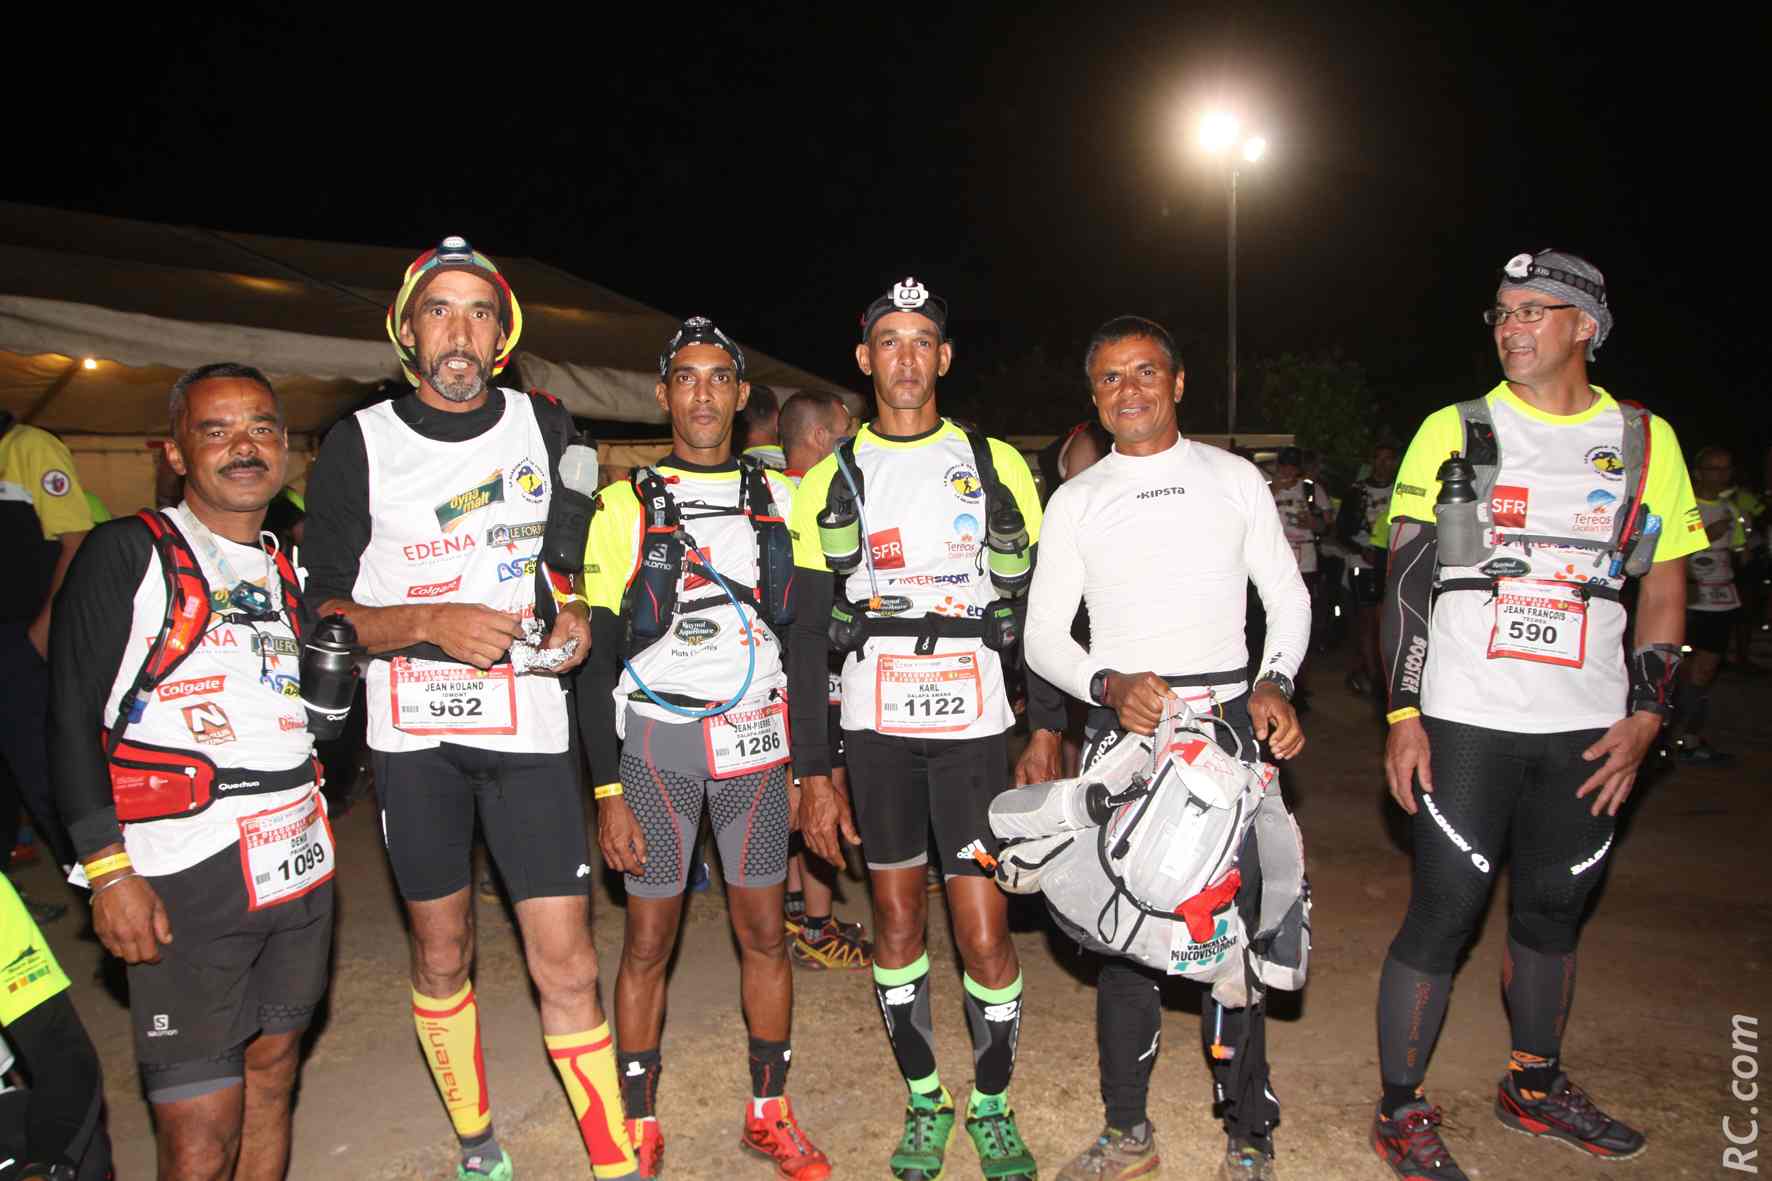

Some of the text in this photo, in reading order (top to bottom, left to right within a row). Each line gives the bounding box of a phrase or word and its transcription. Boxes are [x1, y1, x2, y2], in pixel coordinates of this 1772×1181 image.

[1491, 498, 1526, 515] SFR
[403, 534, 476, 560] EDENA
[872, 542, 902, 560] SFR
[1503, 605, 1525, 615] JEAN
[1508, 620, 1558, 645] 590
[1400, 634, 1428, 694] BOOSTER
[160, 679, 220, 697] Colgate
[425, 683, 447, 692] JEAN
[919, 683, 940, 692] KARL
[430, 697, 483, 717] 962
[904, 697, 965, 717] 1122
[191, 703, 227, 733] N
[735, 731, 780, 757] 1286
[218, 780, 260, 791] Quechua
[278, 842, 325, 881] 1099
